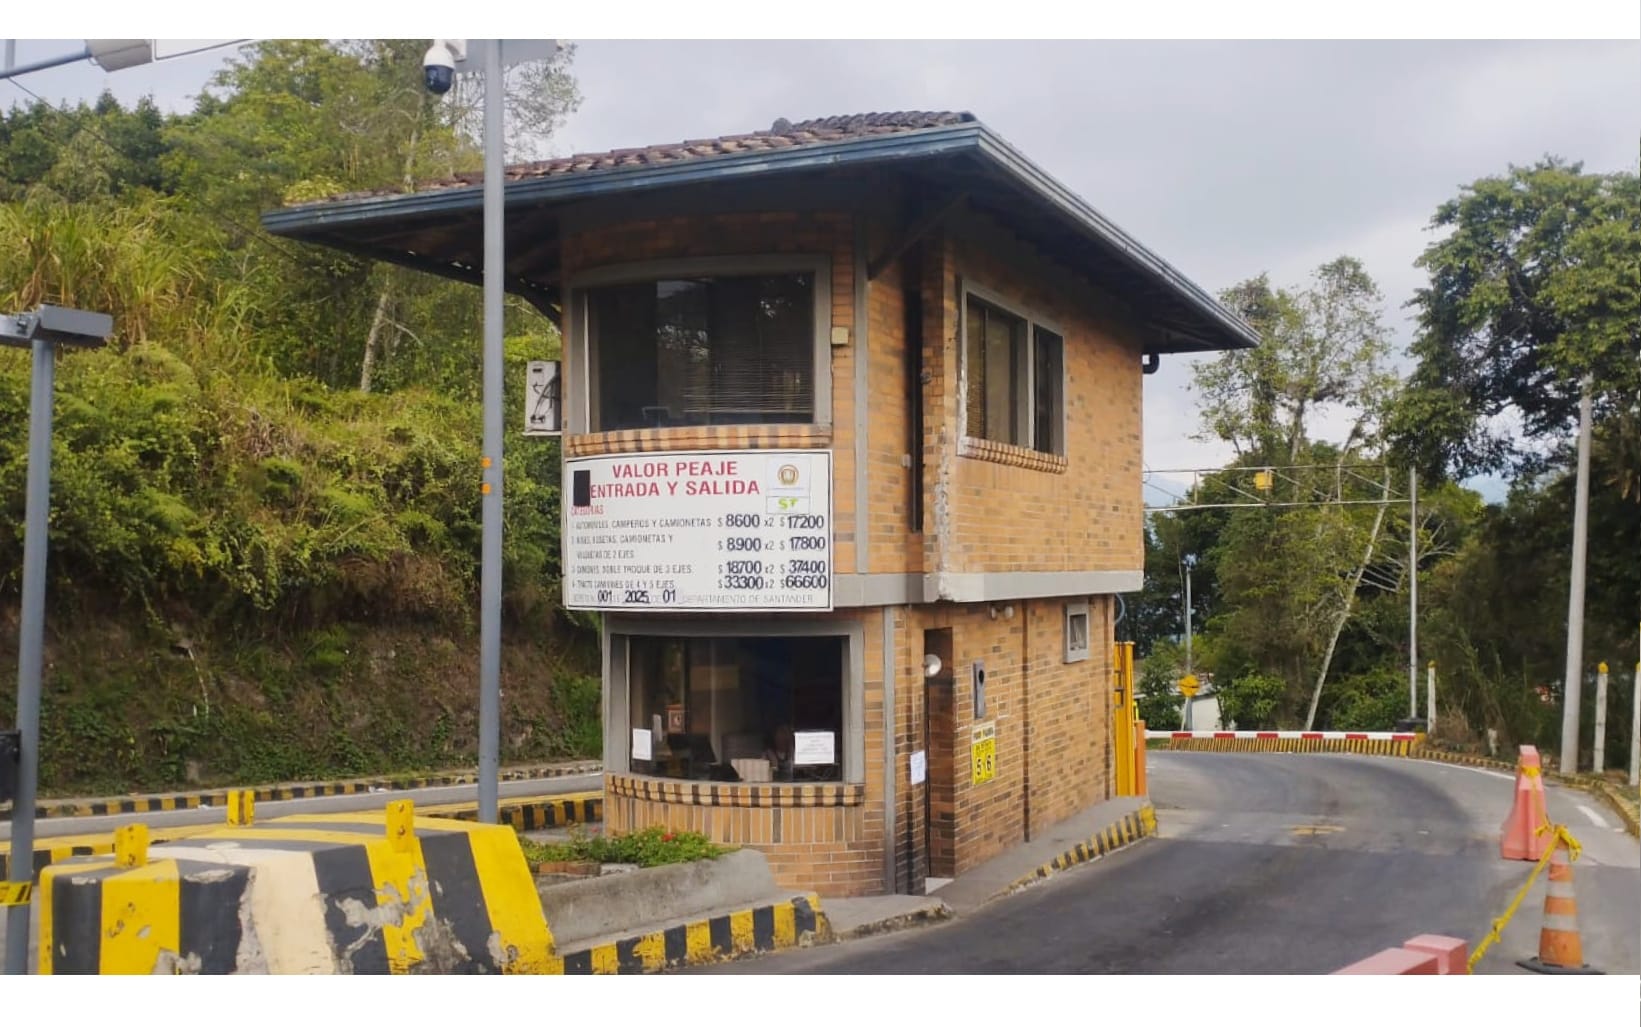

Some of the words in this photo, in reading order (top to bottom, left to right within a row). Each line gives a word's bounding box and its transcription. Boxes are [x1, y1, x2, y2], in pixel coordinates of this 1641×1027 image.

[612, 463, 668, 478] VALOR
[676, 461, 738, 476] PEAJE
[590, 482, 660, 498] ENTRADA
[667, 481, 678, 496] Y
[686, 480, 760, 496] SALIDA
[652, 518, 657, 528] Y
[660, 518, 712, 528] CAMIONETAS
[726, 514, 760, 528] 8600
[787, 515, 824, 529] 17200
[668, 534, 674, 544] Y
[726, 538, 762, 552] 8900
[789, 536, 826, 551] 17800
[653, 564, 663, 574] DE
[726, 560, 762, 574] 18700
[788, 560, 826, 574] 37400
[724, 576, 764, 590] 33300
[786, 575, 827, 590] 66600
[597, 590, 613, 602] 001
[624, 590, 650, 604] 2025
[662, 588, 677, 604] 01
[763, 594, 813, 604] SANTANDER
